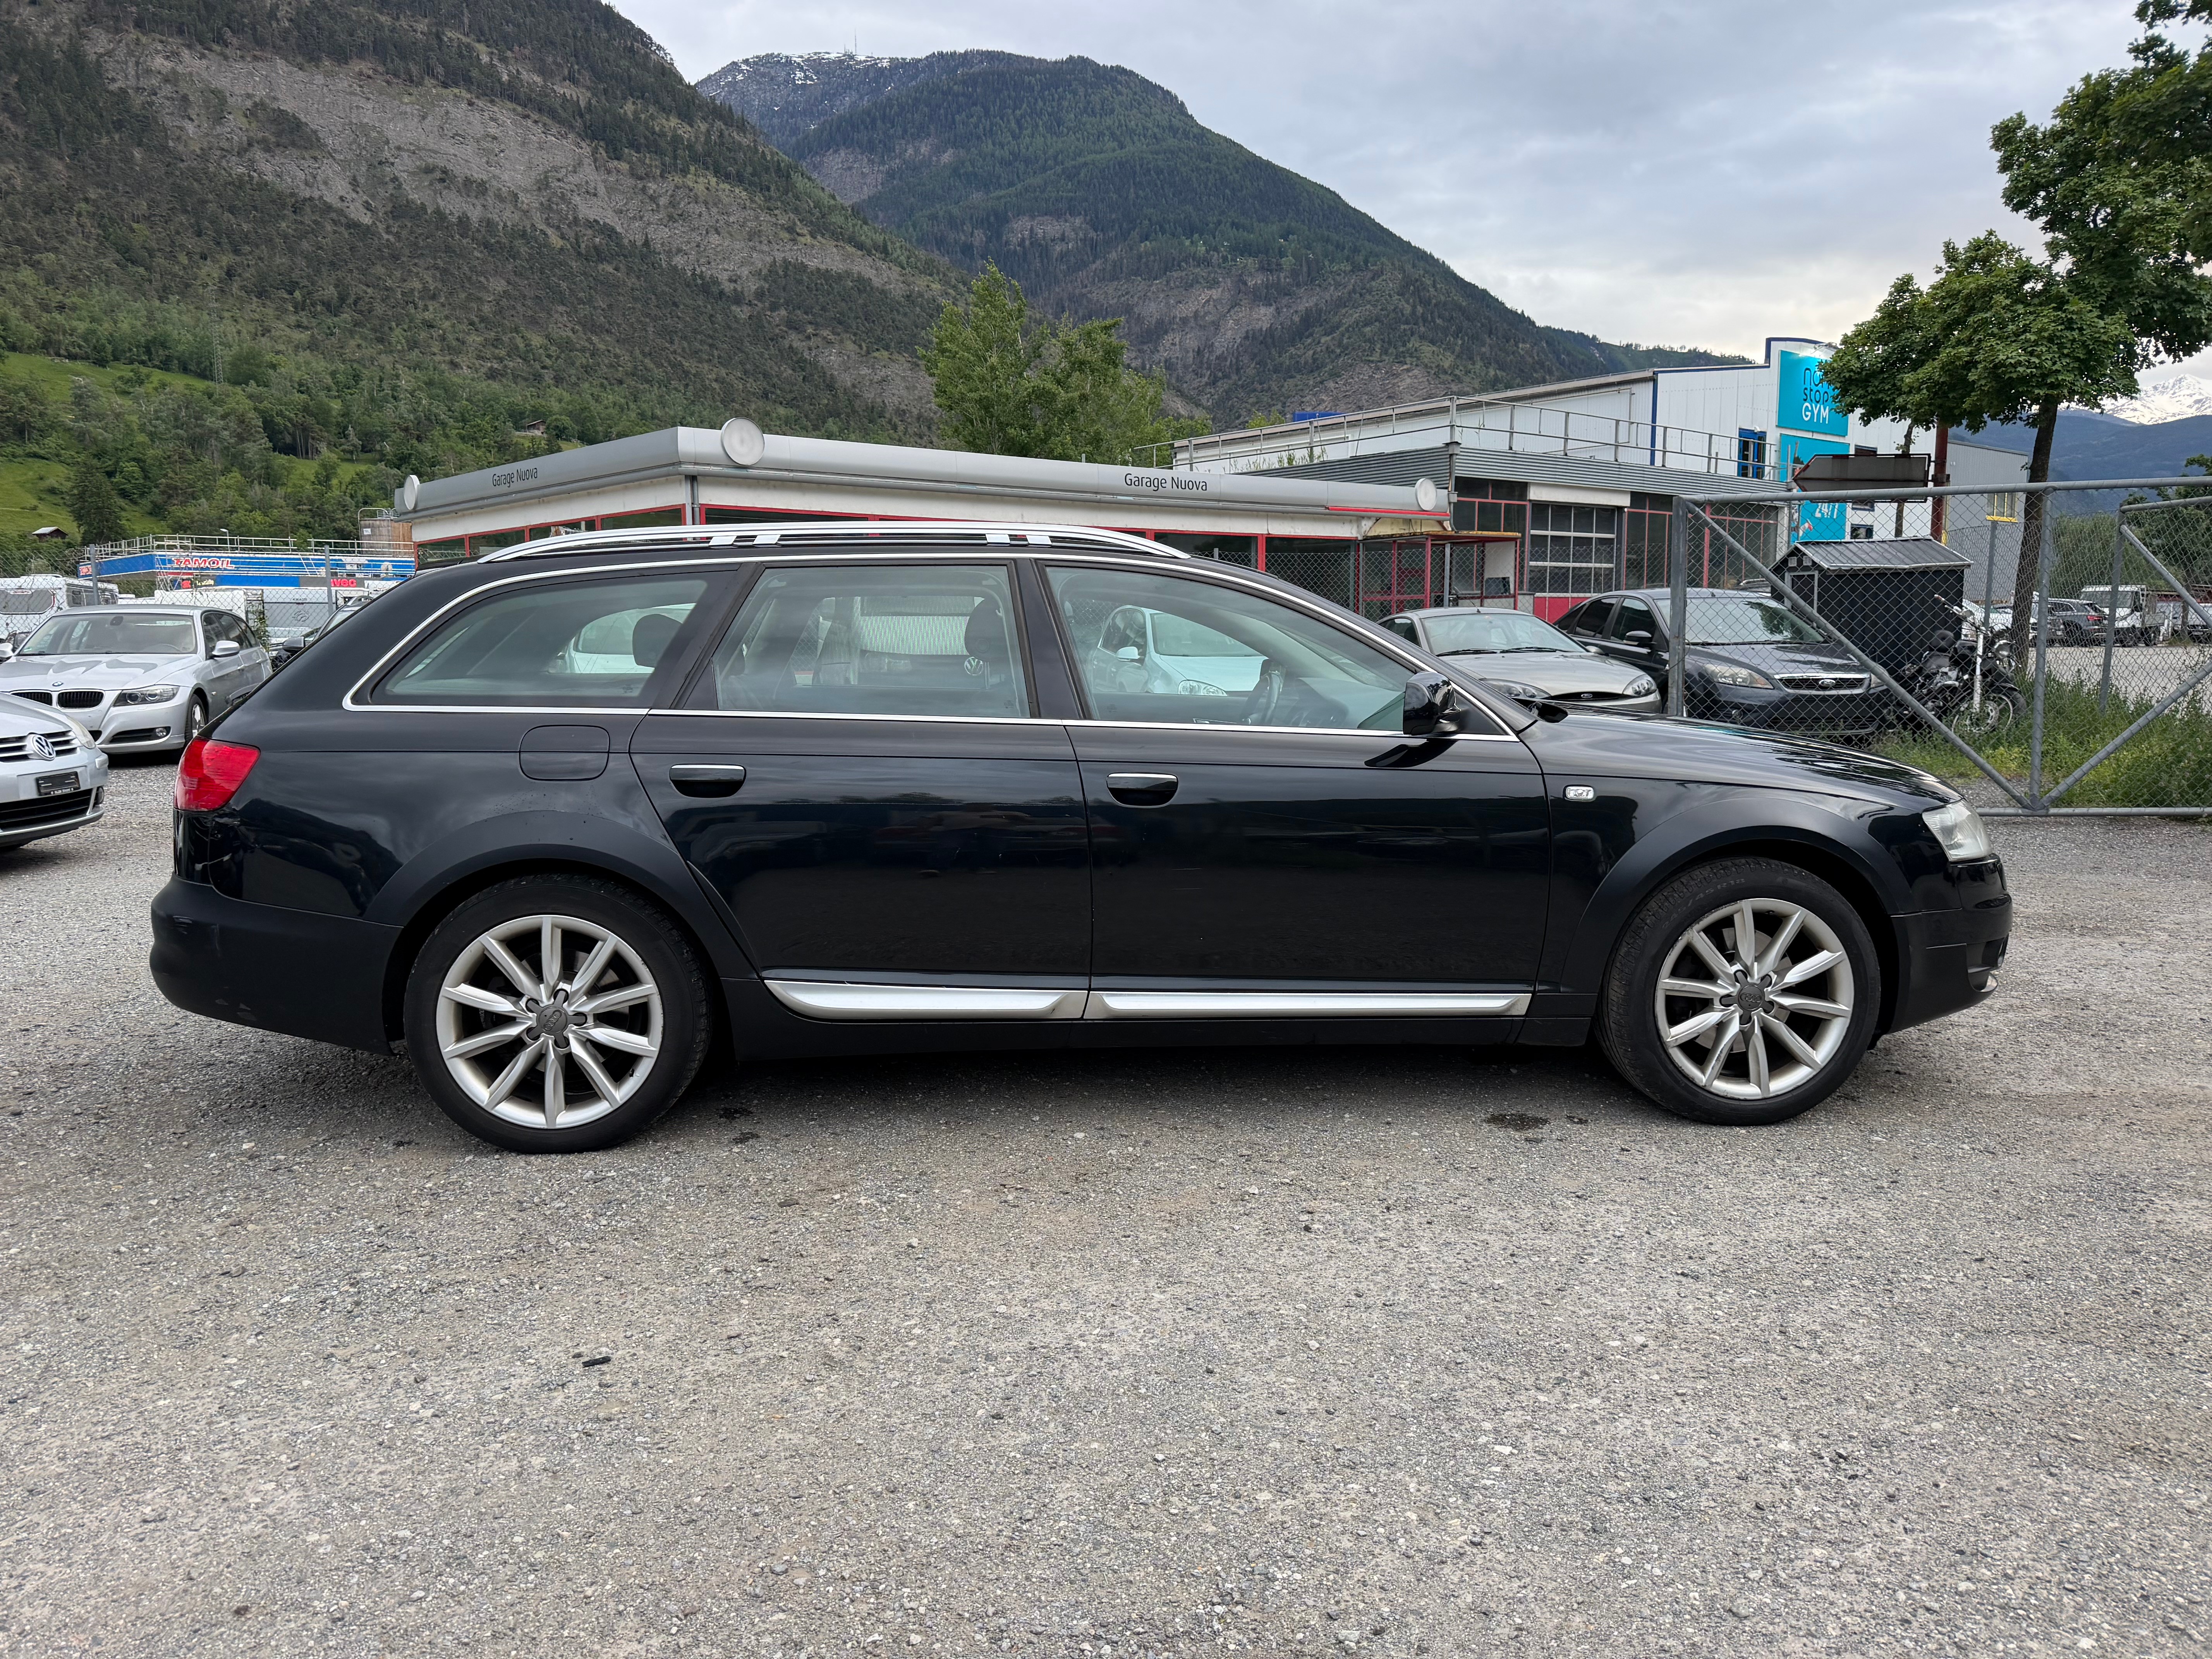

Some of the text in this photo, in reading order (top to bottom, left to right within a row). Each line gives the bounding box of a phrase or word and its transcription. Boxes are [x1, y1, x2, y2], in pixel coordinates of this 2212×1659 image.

[1803, 387, 1829, 404] stop
[1802, 402, 1829, 424] GYM
[492, 467, 538, 488] Garage Nuova
[1125, 473, 1207, 491] Garage Nuova
[172, 558, 235, 568] TAMOIL
[1716, 878, 1746, 890] R18
